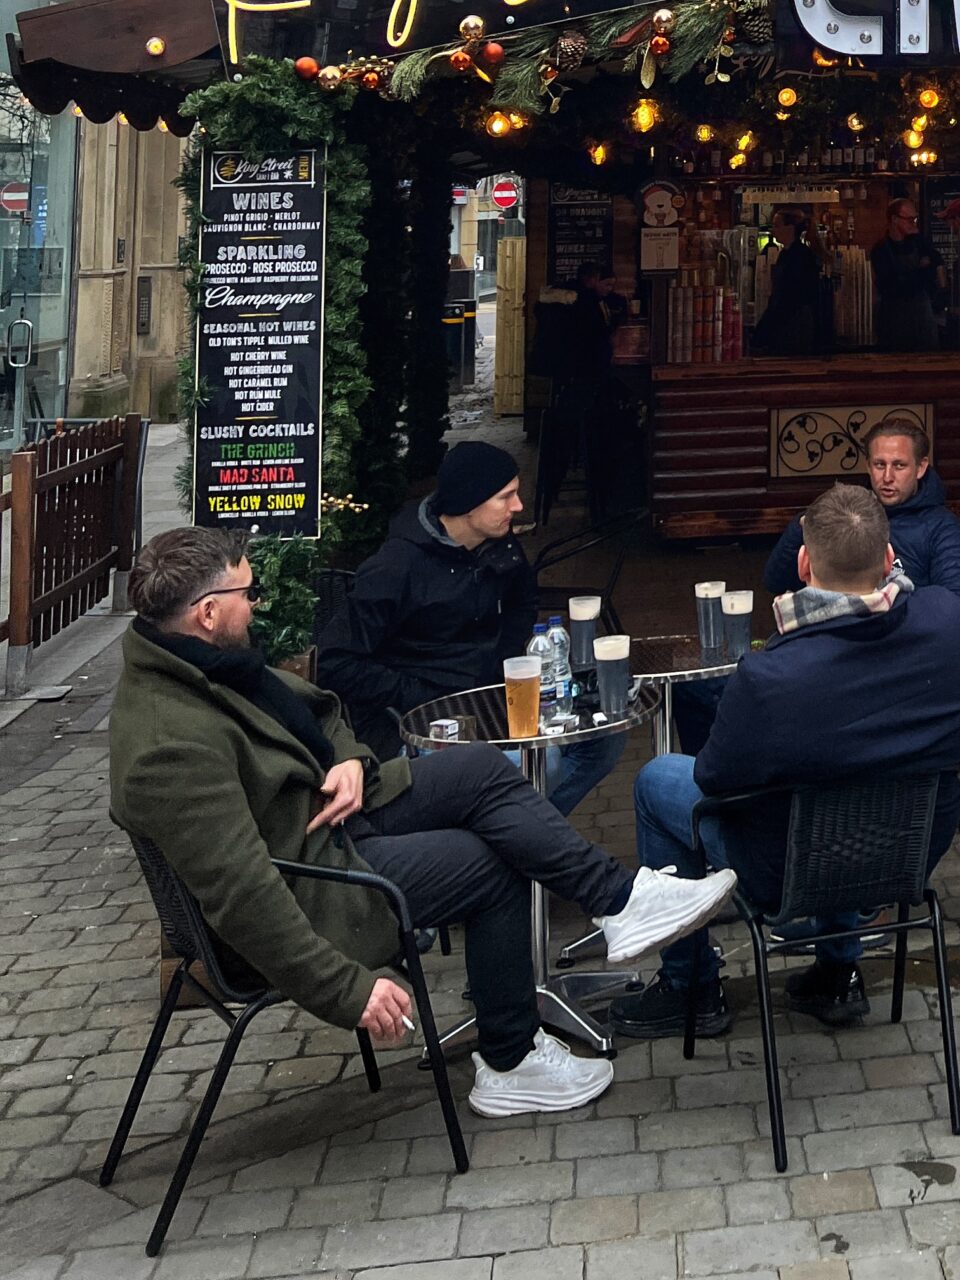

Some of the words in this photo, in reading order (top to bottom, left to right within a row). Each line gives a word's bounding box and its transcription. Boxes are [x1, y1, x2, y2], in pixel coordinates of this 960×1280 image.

[234, 159, 260, 178] King
[261, 157, 295, 172] Street
[298, 156, 309, 180] MENU
[232, 192, 293, 210] WINES
[224, 213, 244, 221] PINOT
[246, 213, 268, 221] GRIGIO
[275, 212, 300, 220] MERLOT
[203, 224, 242, 232] SAUVIGNON
[244, 223, 266, 231] BLANC
[273, 222, 320, 231] CHARDONNAY
[217, 244, 306, 261] SPARKLING
[205, 263, 246, 275] PROSECCO
[253, 262, 273, 273] ROSE
[275, 261, 317, 273] PROSECCO
[205, 285, 316, 311] Champagne
[203, 322, 257, 334] SEASONAL
[259, 322, 280, 332] HOT
[282, 321, 316, 331] WINES
[209, 337, 221, 347] OLD
[222, 337, 242, 346] TOM'S
[243, 336, 265, 346] TIPPLE
[268, 335, 292, 345] MULLED
[293, 335, 309, 344] WINE
[230, 352, 245, 361] HOT
[245, 351, 270, 361] CHERRY
[270, 351, 287, 360] WINE
[224, 366, 238, 376] HOT
[238, 365, 281, 375] GINGERBREAD
[282, 364, 293, 374] GIN
[229, 379, 243, 388] HOT
[243, 378, 272, 388] CARAMEL
[273, 377, 288, 387] RUM
[234, 391, 248, 400] HOT
[249, 390, 263, 399] RUM
[264, 389, 281, 399] MULE
[241, 403, 255, 412] HOT
[255, 402, 274, 411] CIDER
[200, 425, 244, 440] SLUSHY
[249, 423, 315, 437] COCKTAILS
[220, 443, 244, 459] THE
[247, 442, 296, 459] GRINCH
[219, 468, 248, 483] MAD
[252, 467, 295, 482] SANTA
[208, 495, 261, 512] YELLOW
[267, 494, 305, 510] SNOW
